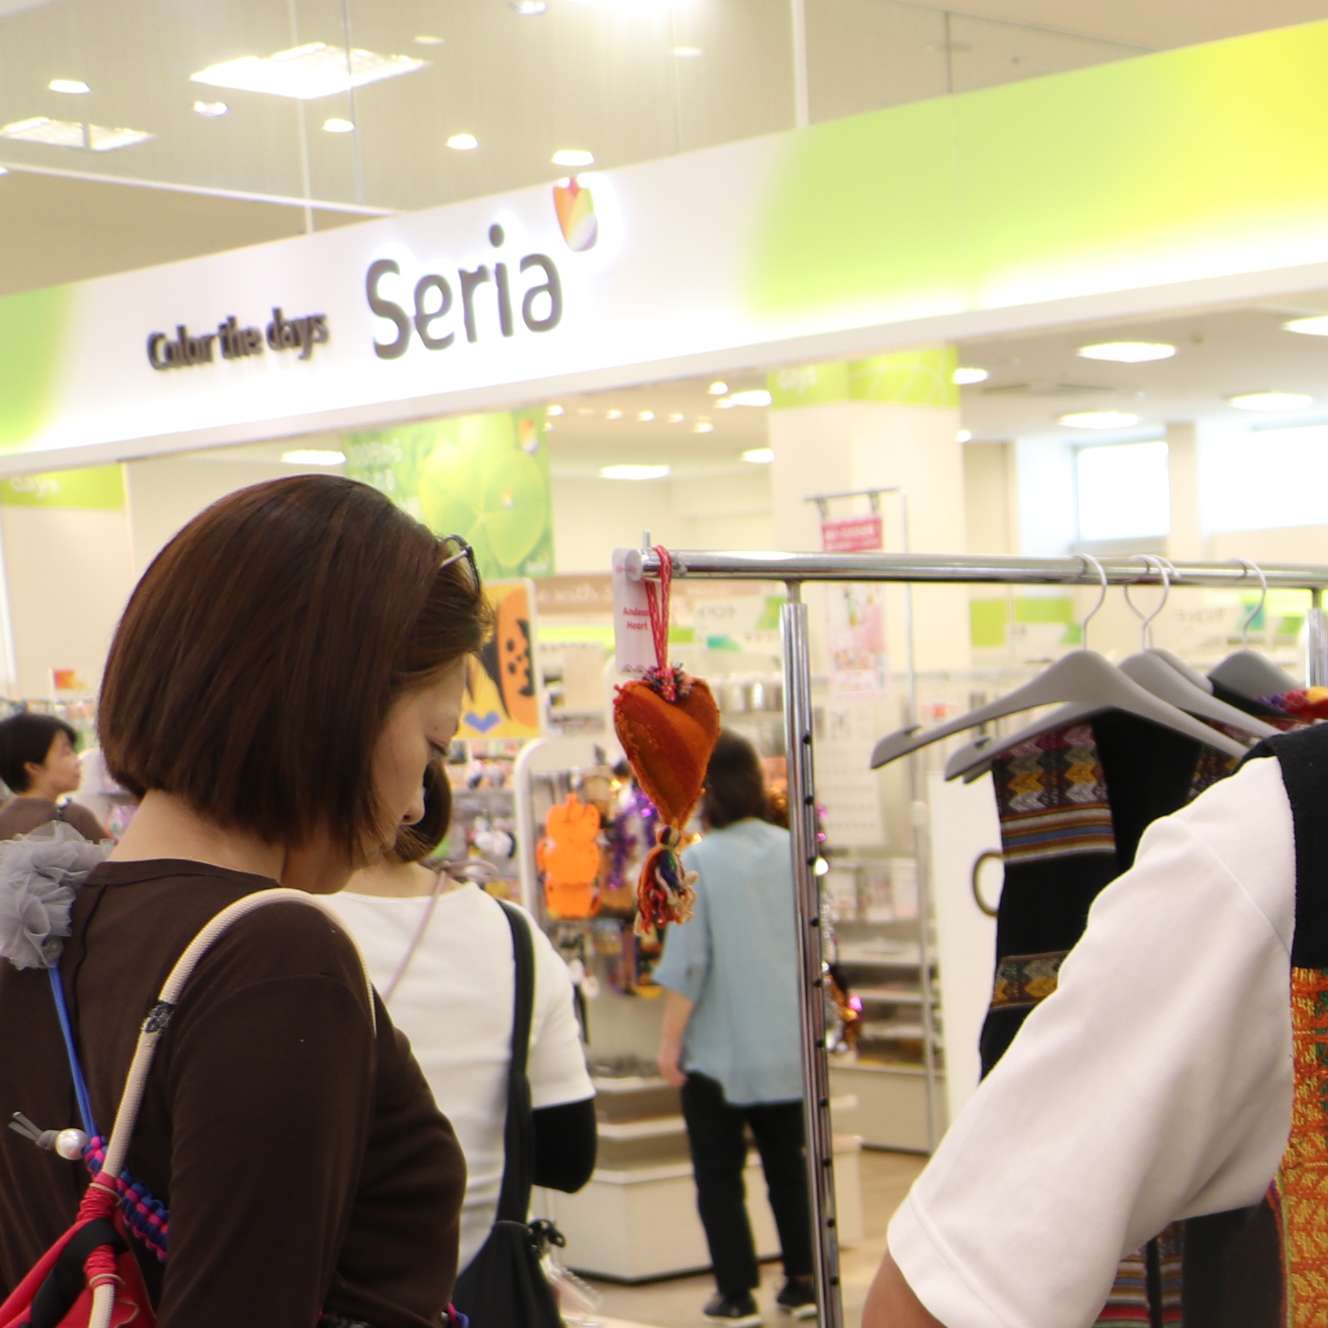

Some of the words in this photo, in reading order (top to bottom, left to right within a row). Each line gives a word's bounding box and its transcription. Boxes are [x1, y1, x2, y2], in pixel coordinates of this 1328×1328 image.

[366, 223, 564, 360] Seria
[147, 324, 215, 371] Color
[217, 315, 264, 360] the
[266, 306, 329, 360] days
[627, 620, 648, 631] Heart
